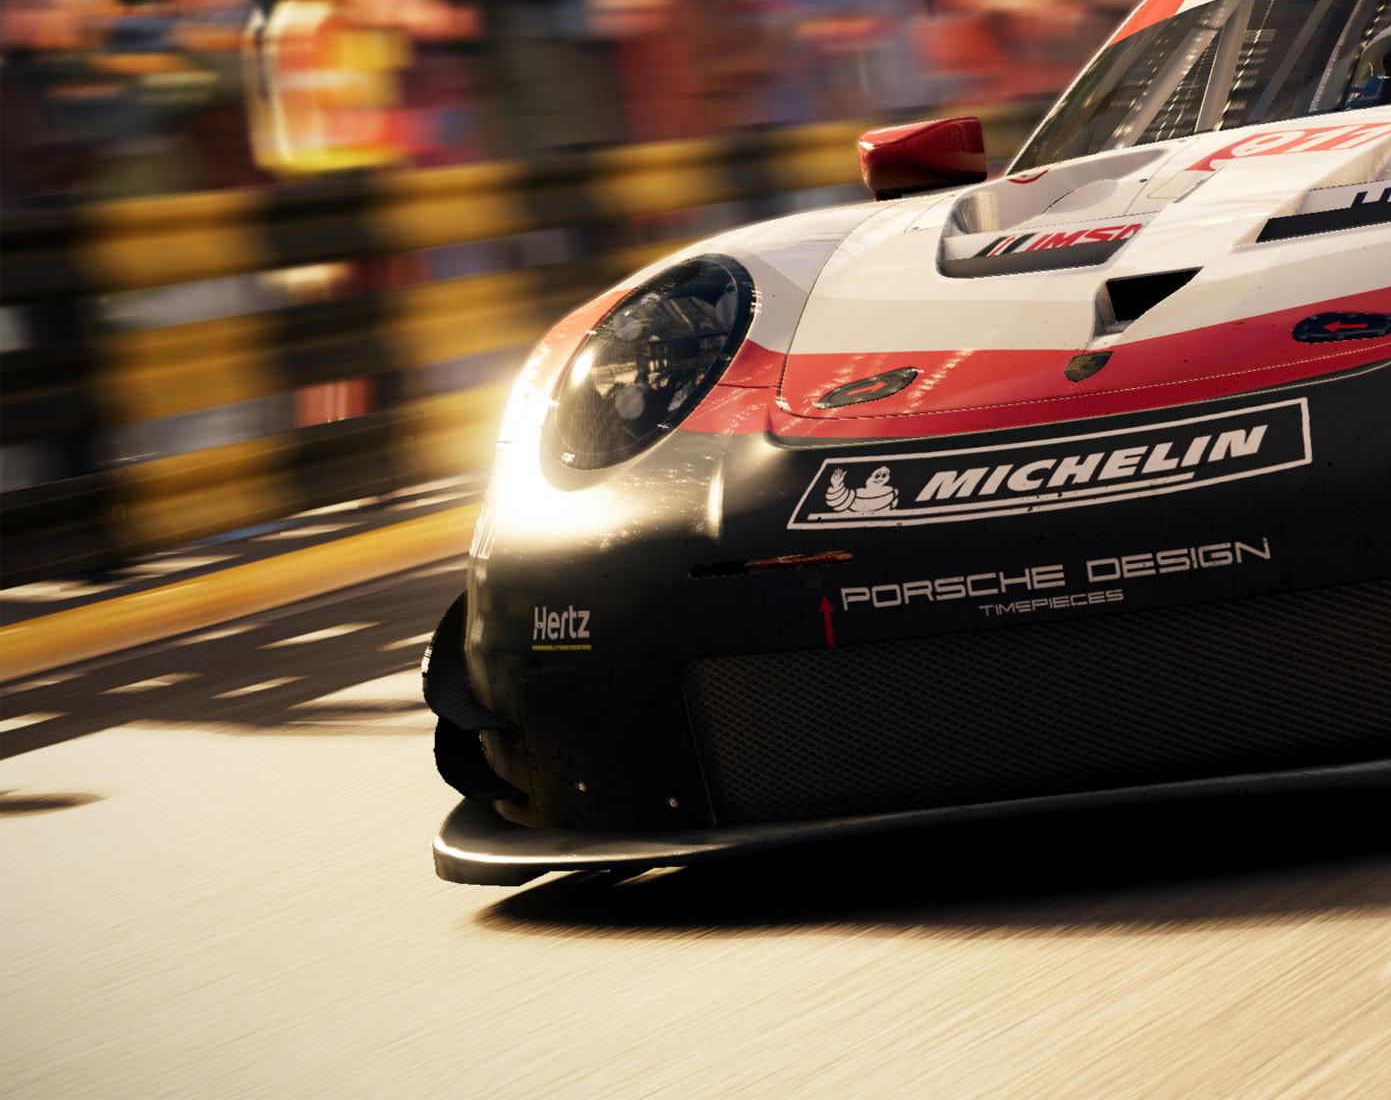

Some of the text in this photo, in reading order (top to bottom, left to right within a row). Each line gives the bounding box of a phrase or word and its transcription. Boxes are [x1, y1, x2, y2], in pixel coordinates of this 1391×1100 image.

[915, 424, 1269, 503] MICHELIN
[840, 537, 1272, 611] PORSCHE DESIGN
[533, 605, 591, 641] Hertz
[978, 588, 1125, 618] TIMEPIECES
